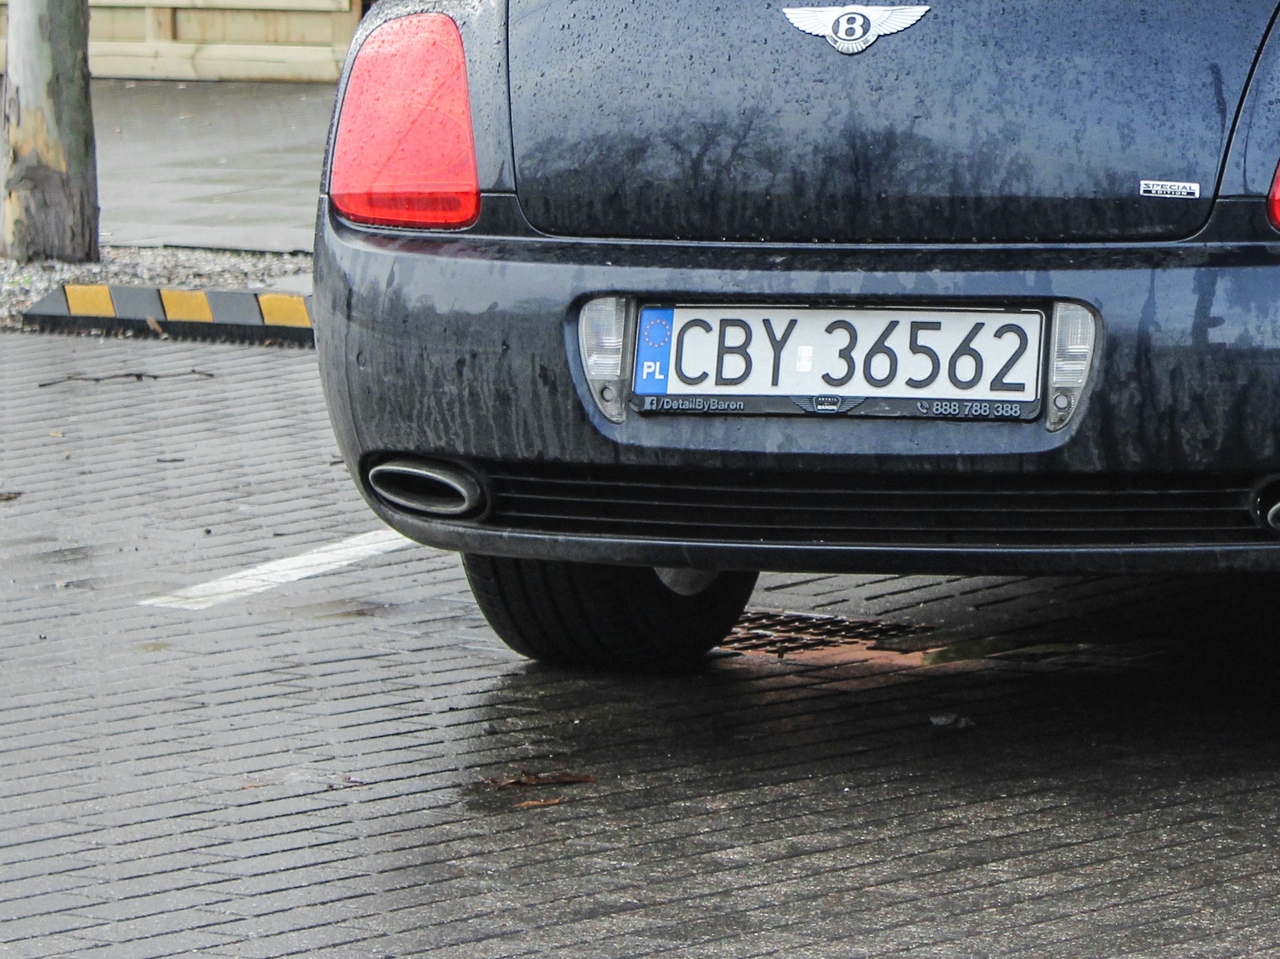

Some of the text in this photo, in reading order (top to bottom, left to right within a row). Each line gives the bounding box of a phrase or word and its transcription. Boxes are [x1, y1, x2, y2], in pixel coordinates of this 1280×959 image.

[1143, 183, 1196, 192] SPECIAL
[674, 318, 1027, 392] CBY 36562
[643, 362, 665, 380] PL
[933, 402, 1020, 417] 888 788 388
